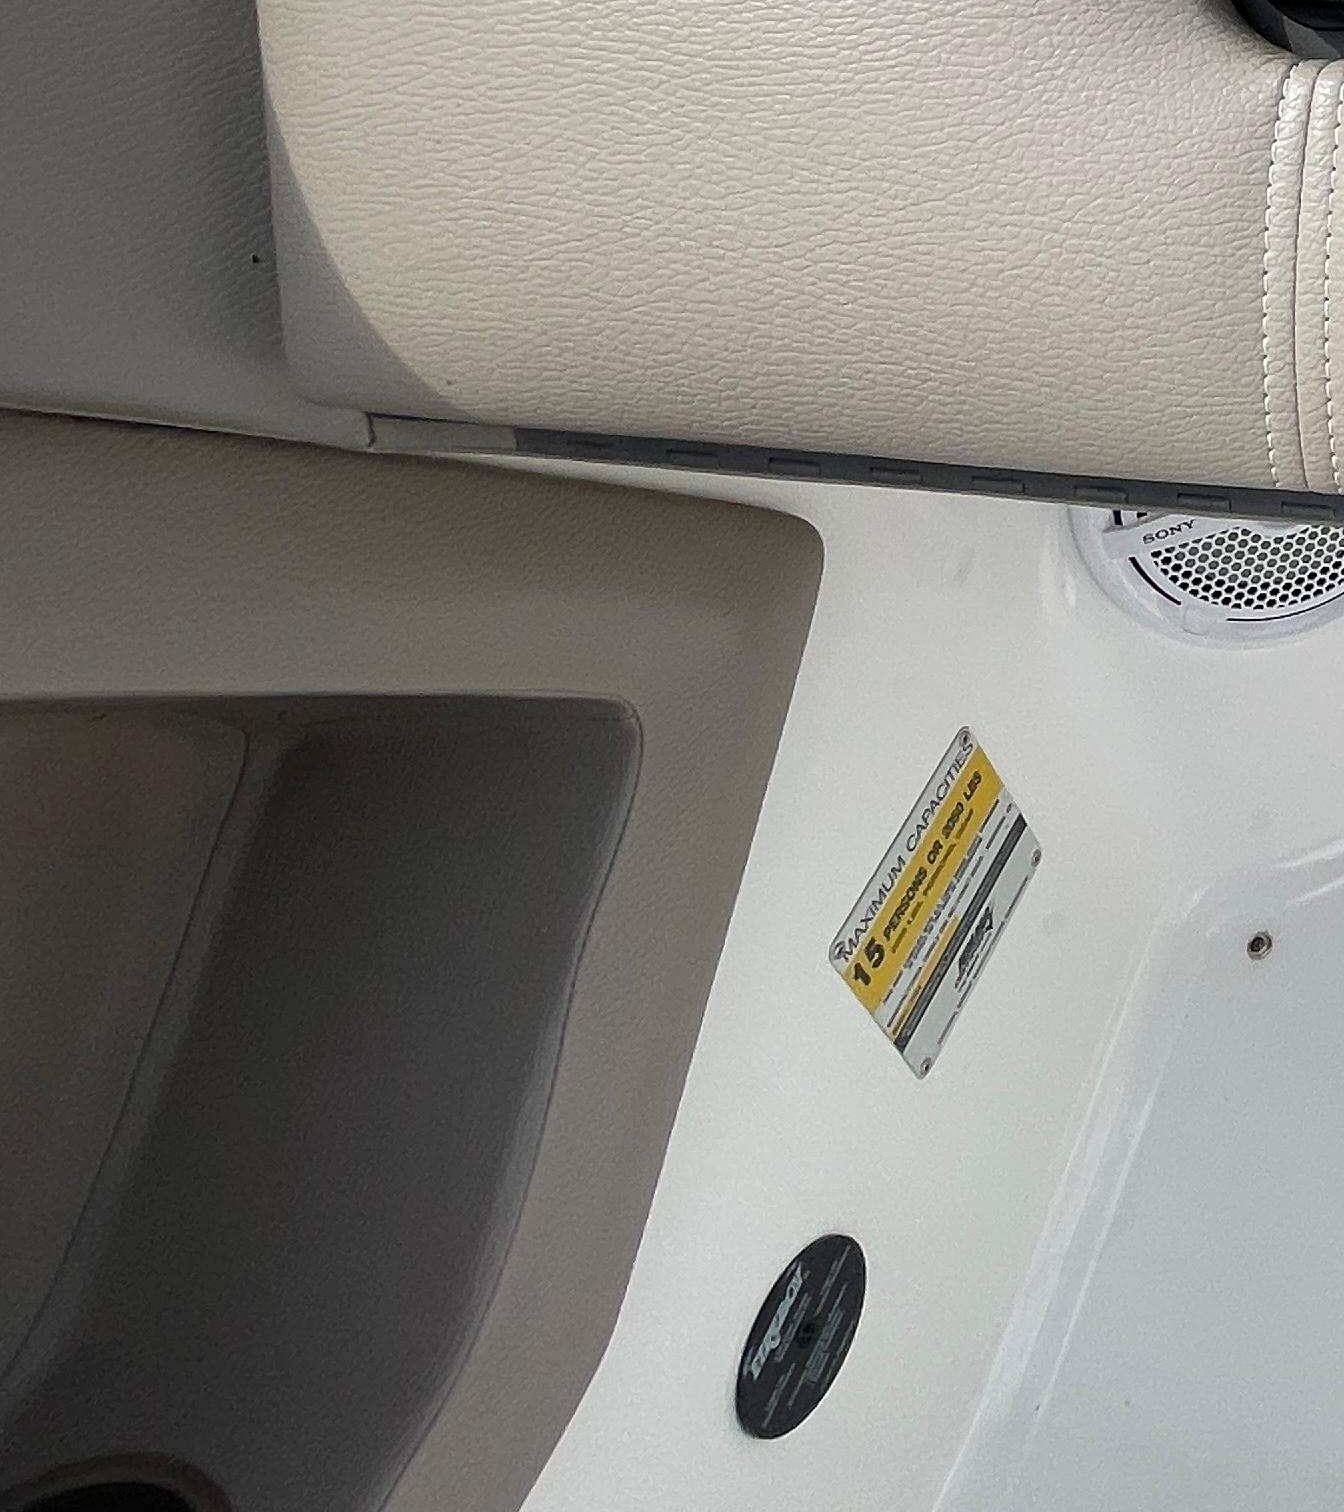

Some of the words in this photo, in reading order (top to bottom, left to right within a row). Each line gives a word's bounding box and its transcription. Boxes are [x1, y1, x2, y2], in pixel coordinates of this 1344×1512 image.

[1143, 519, 1195, 544] SONY
[842, 855, 906, 963] MAXIMUM
[905, 741, 974, 852] CAPACITIES
[852, 936, 886, 986] 15
[883, 866, 927, 942] PERSONS
[927, 839, 943, 865] OR
